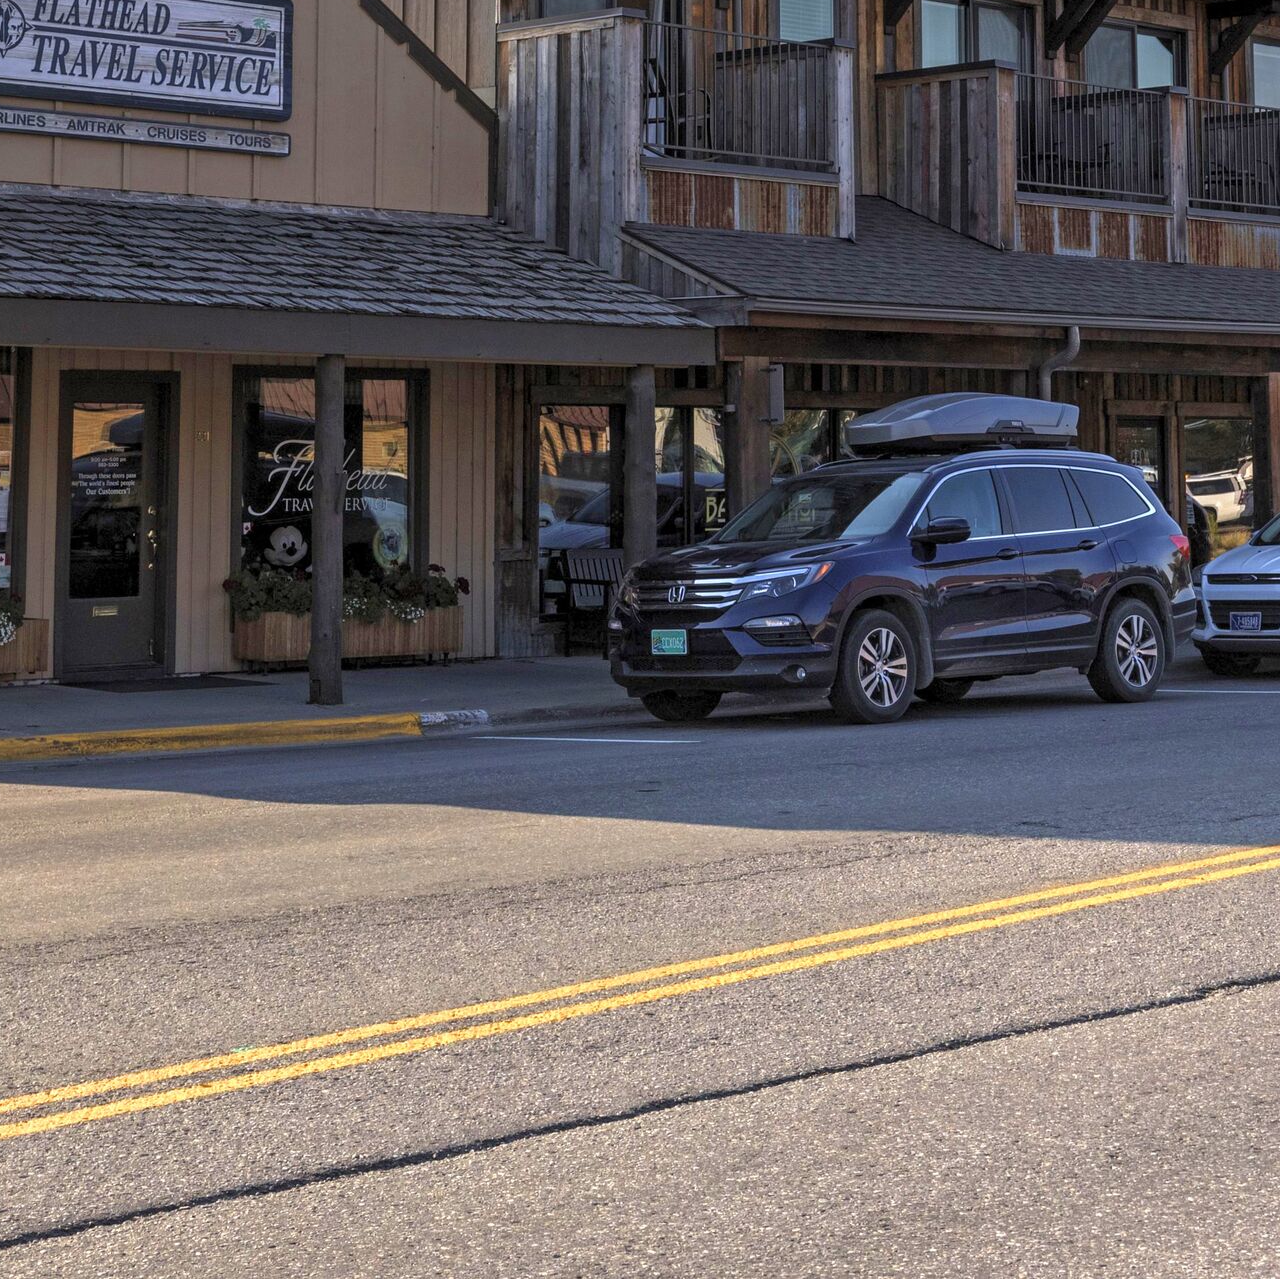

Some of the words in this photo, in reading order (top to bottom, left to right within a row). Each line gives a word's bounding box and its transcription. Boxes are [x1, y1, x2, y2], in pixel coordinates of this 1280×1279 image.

[30, 35, 145, 83] TRAVEL
[150, 48, 276, 97] SERVICE
[65, 118, 126, 136] AMTRAK
[147, 126, 207, 143] CRUISES
[227, 132, 272, 149] TOURS
[344, 497, 392, 512] ERVICE
